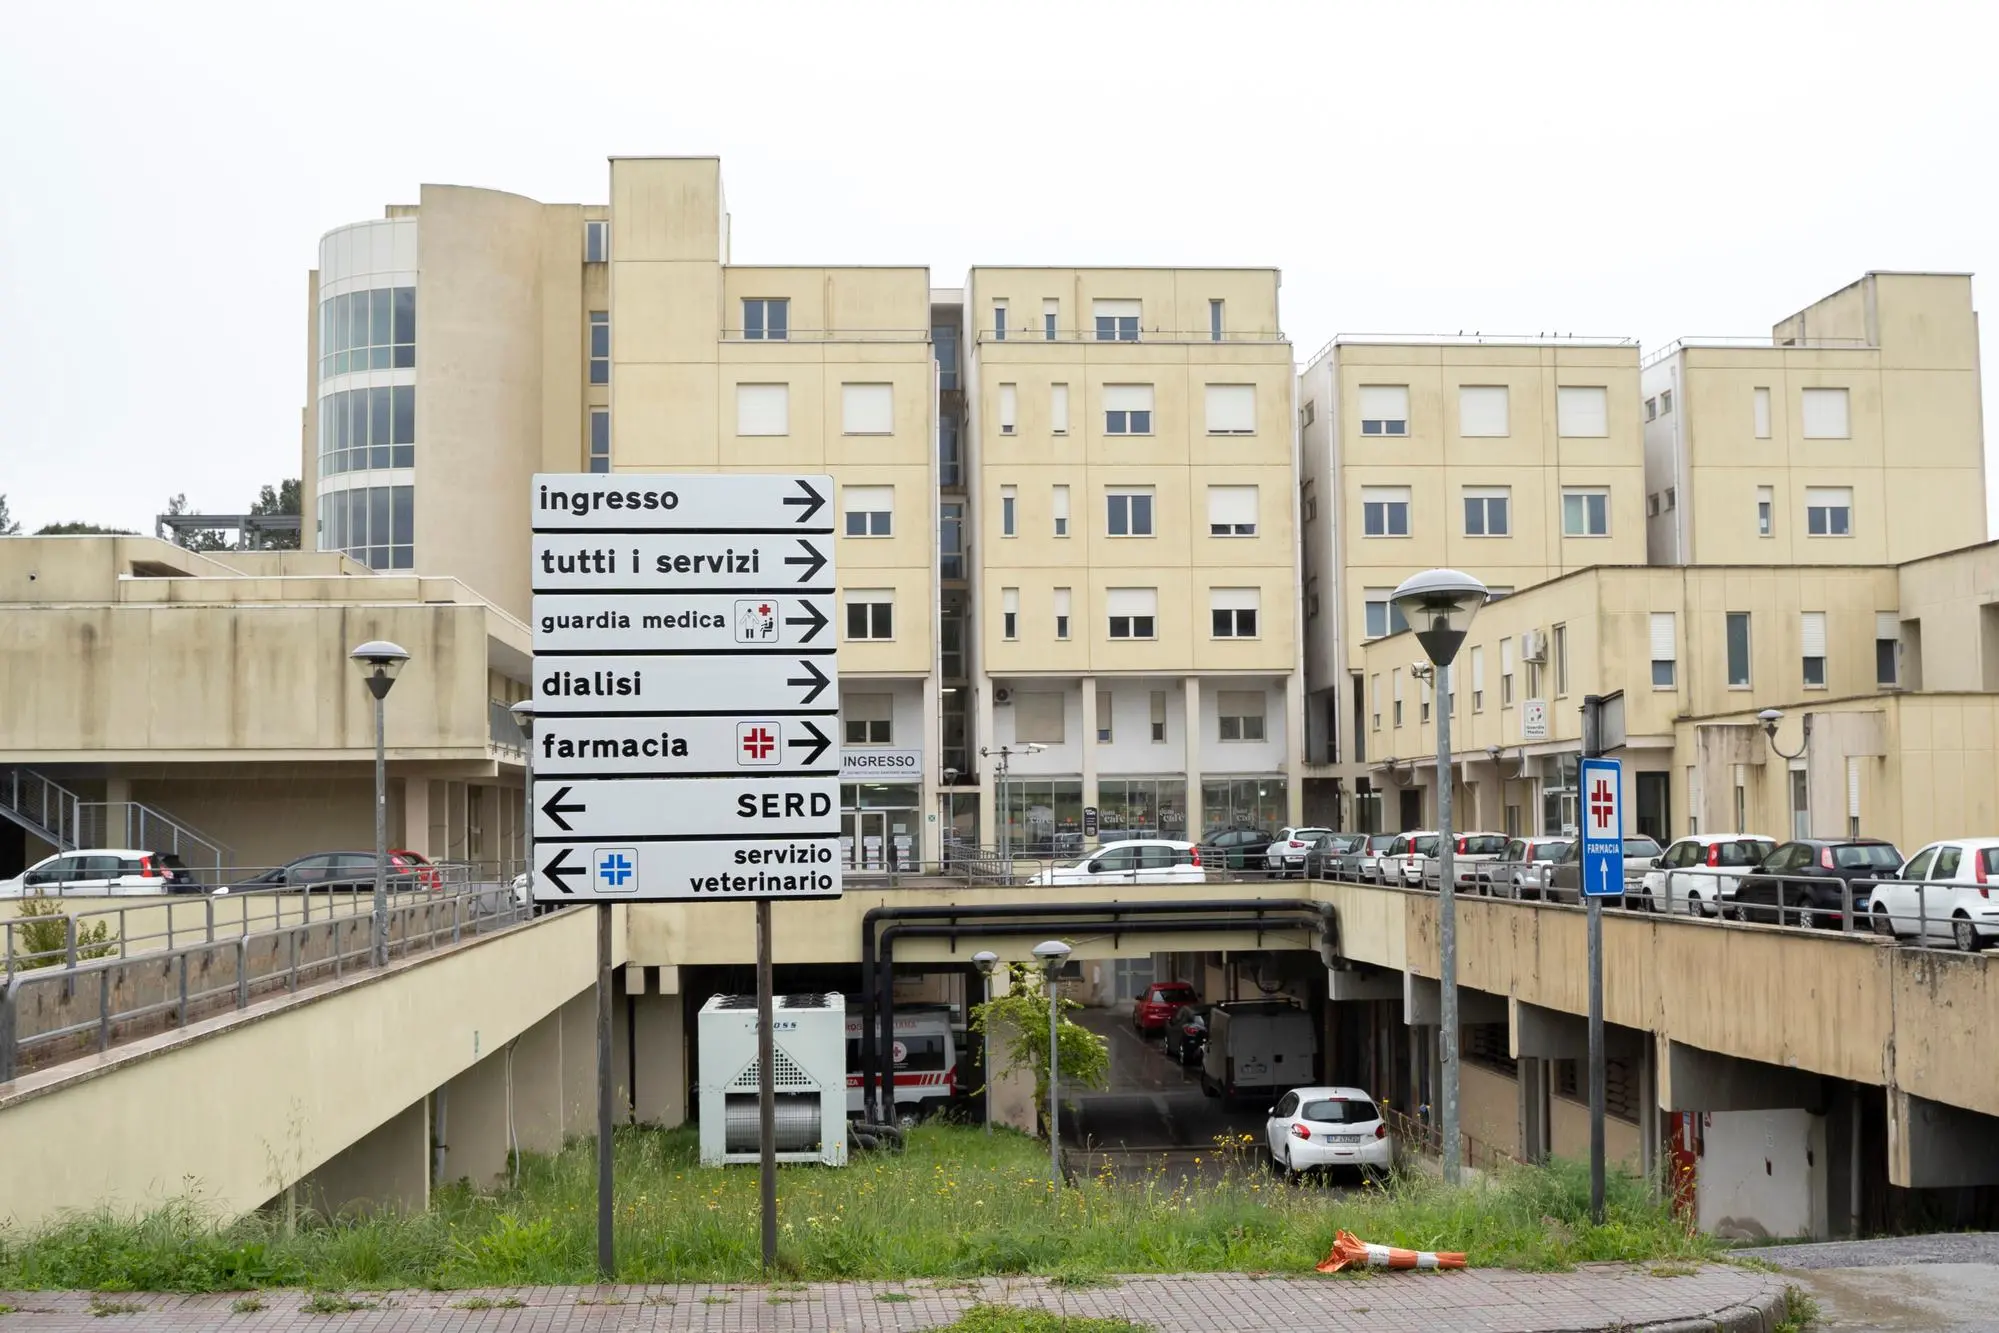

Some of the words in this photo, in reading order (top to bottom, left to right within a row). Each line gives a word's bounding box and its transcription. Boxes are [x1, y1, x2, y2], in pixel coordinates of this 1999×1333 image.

[540, 485, 679, 516] ingresso
[541, 549, 616, 574] tutti
[632, 549, 640, 574] i
[656, 549, 760, 574] servizi
[541, 611, 631, 633] guardia
[642, 611, 726, 629] medica
[542, 671, 642, 697] dialisi
[542, 732, 689, 759] farmacia
[843, 756, 915, 767] INGRESSO
[736, 792, 832, 819] SERD
[733, 843, 832, 865] servizio
[1587, 843, 1620, 854] FARMACIA
[689, 871, 833, 892] veterinario
